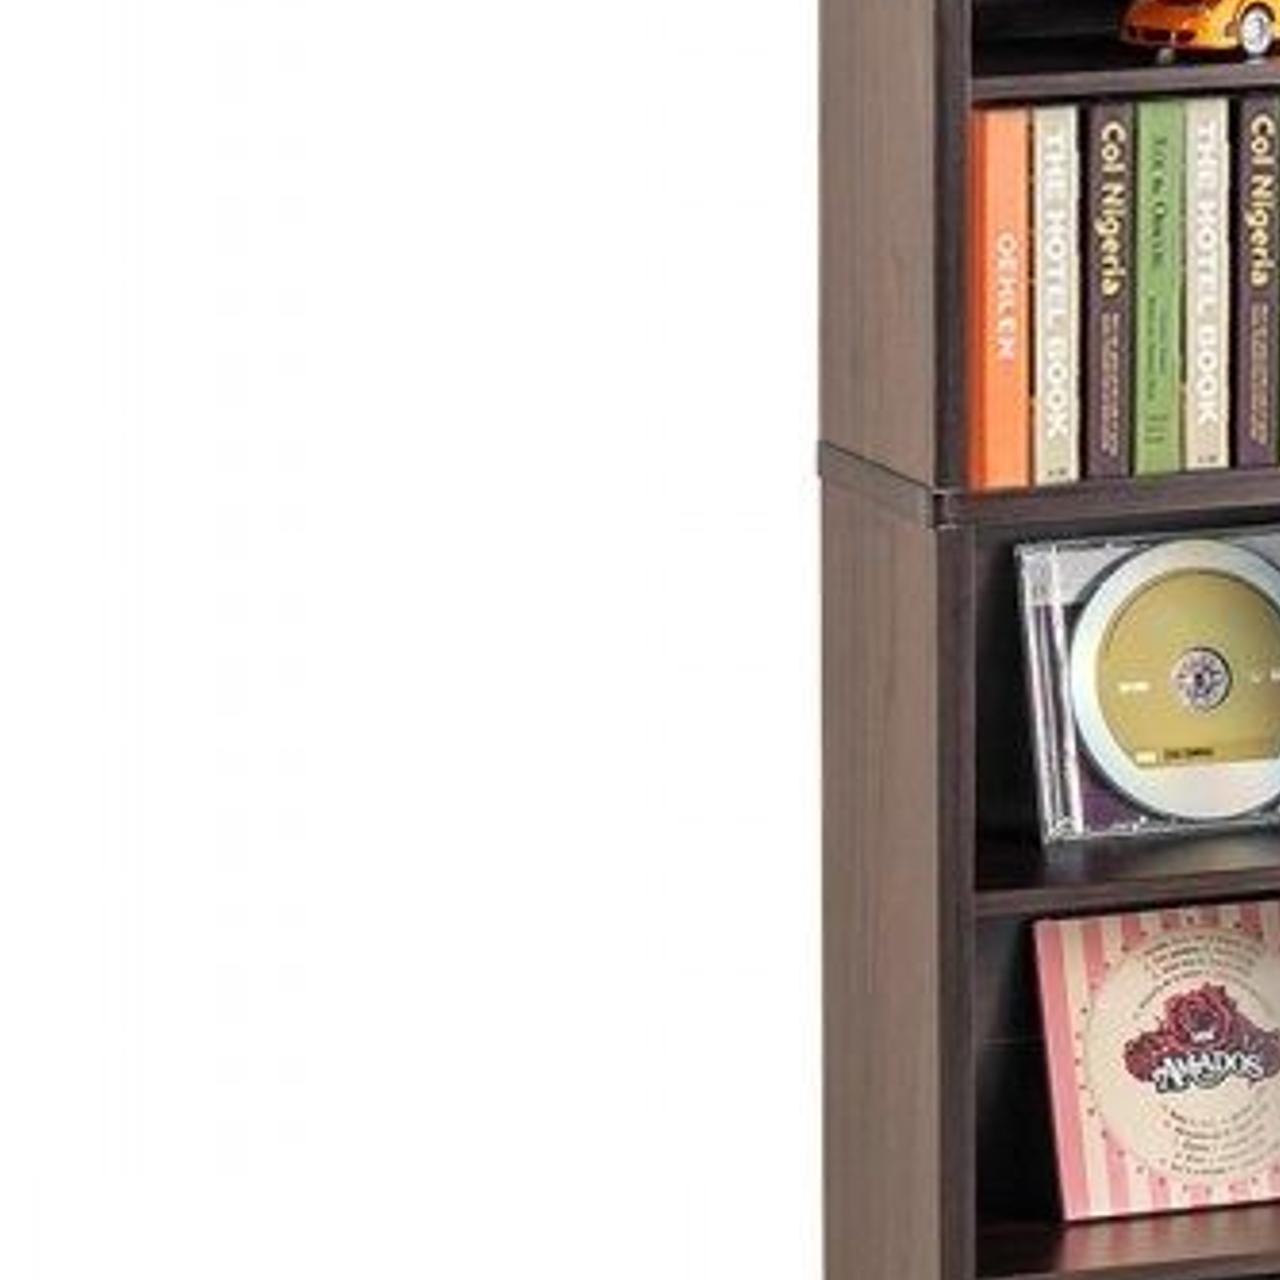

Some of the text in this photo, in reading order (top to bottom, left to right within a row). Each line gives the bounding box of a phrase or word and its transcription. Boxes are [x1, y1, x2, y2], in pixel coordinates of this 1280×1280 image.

[1101, 120, 1126, 173] Col
[1250, 113, 1275, 166] Col
[1045, 129, 1070, 440] THE HOTEL BOOK
[1095, 180, 1127, 296] Nigeria
[1195, 119, 1219, 426] THE HOTEL BOOK
[1244, 173, 1275, 287] Nigeria
